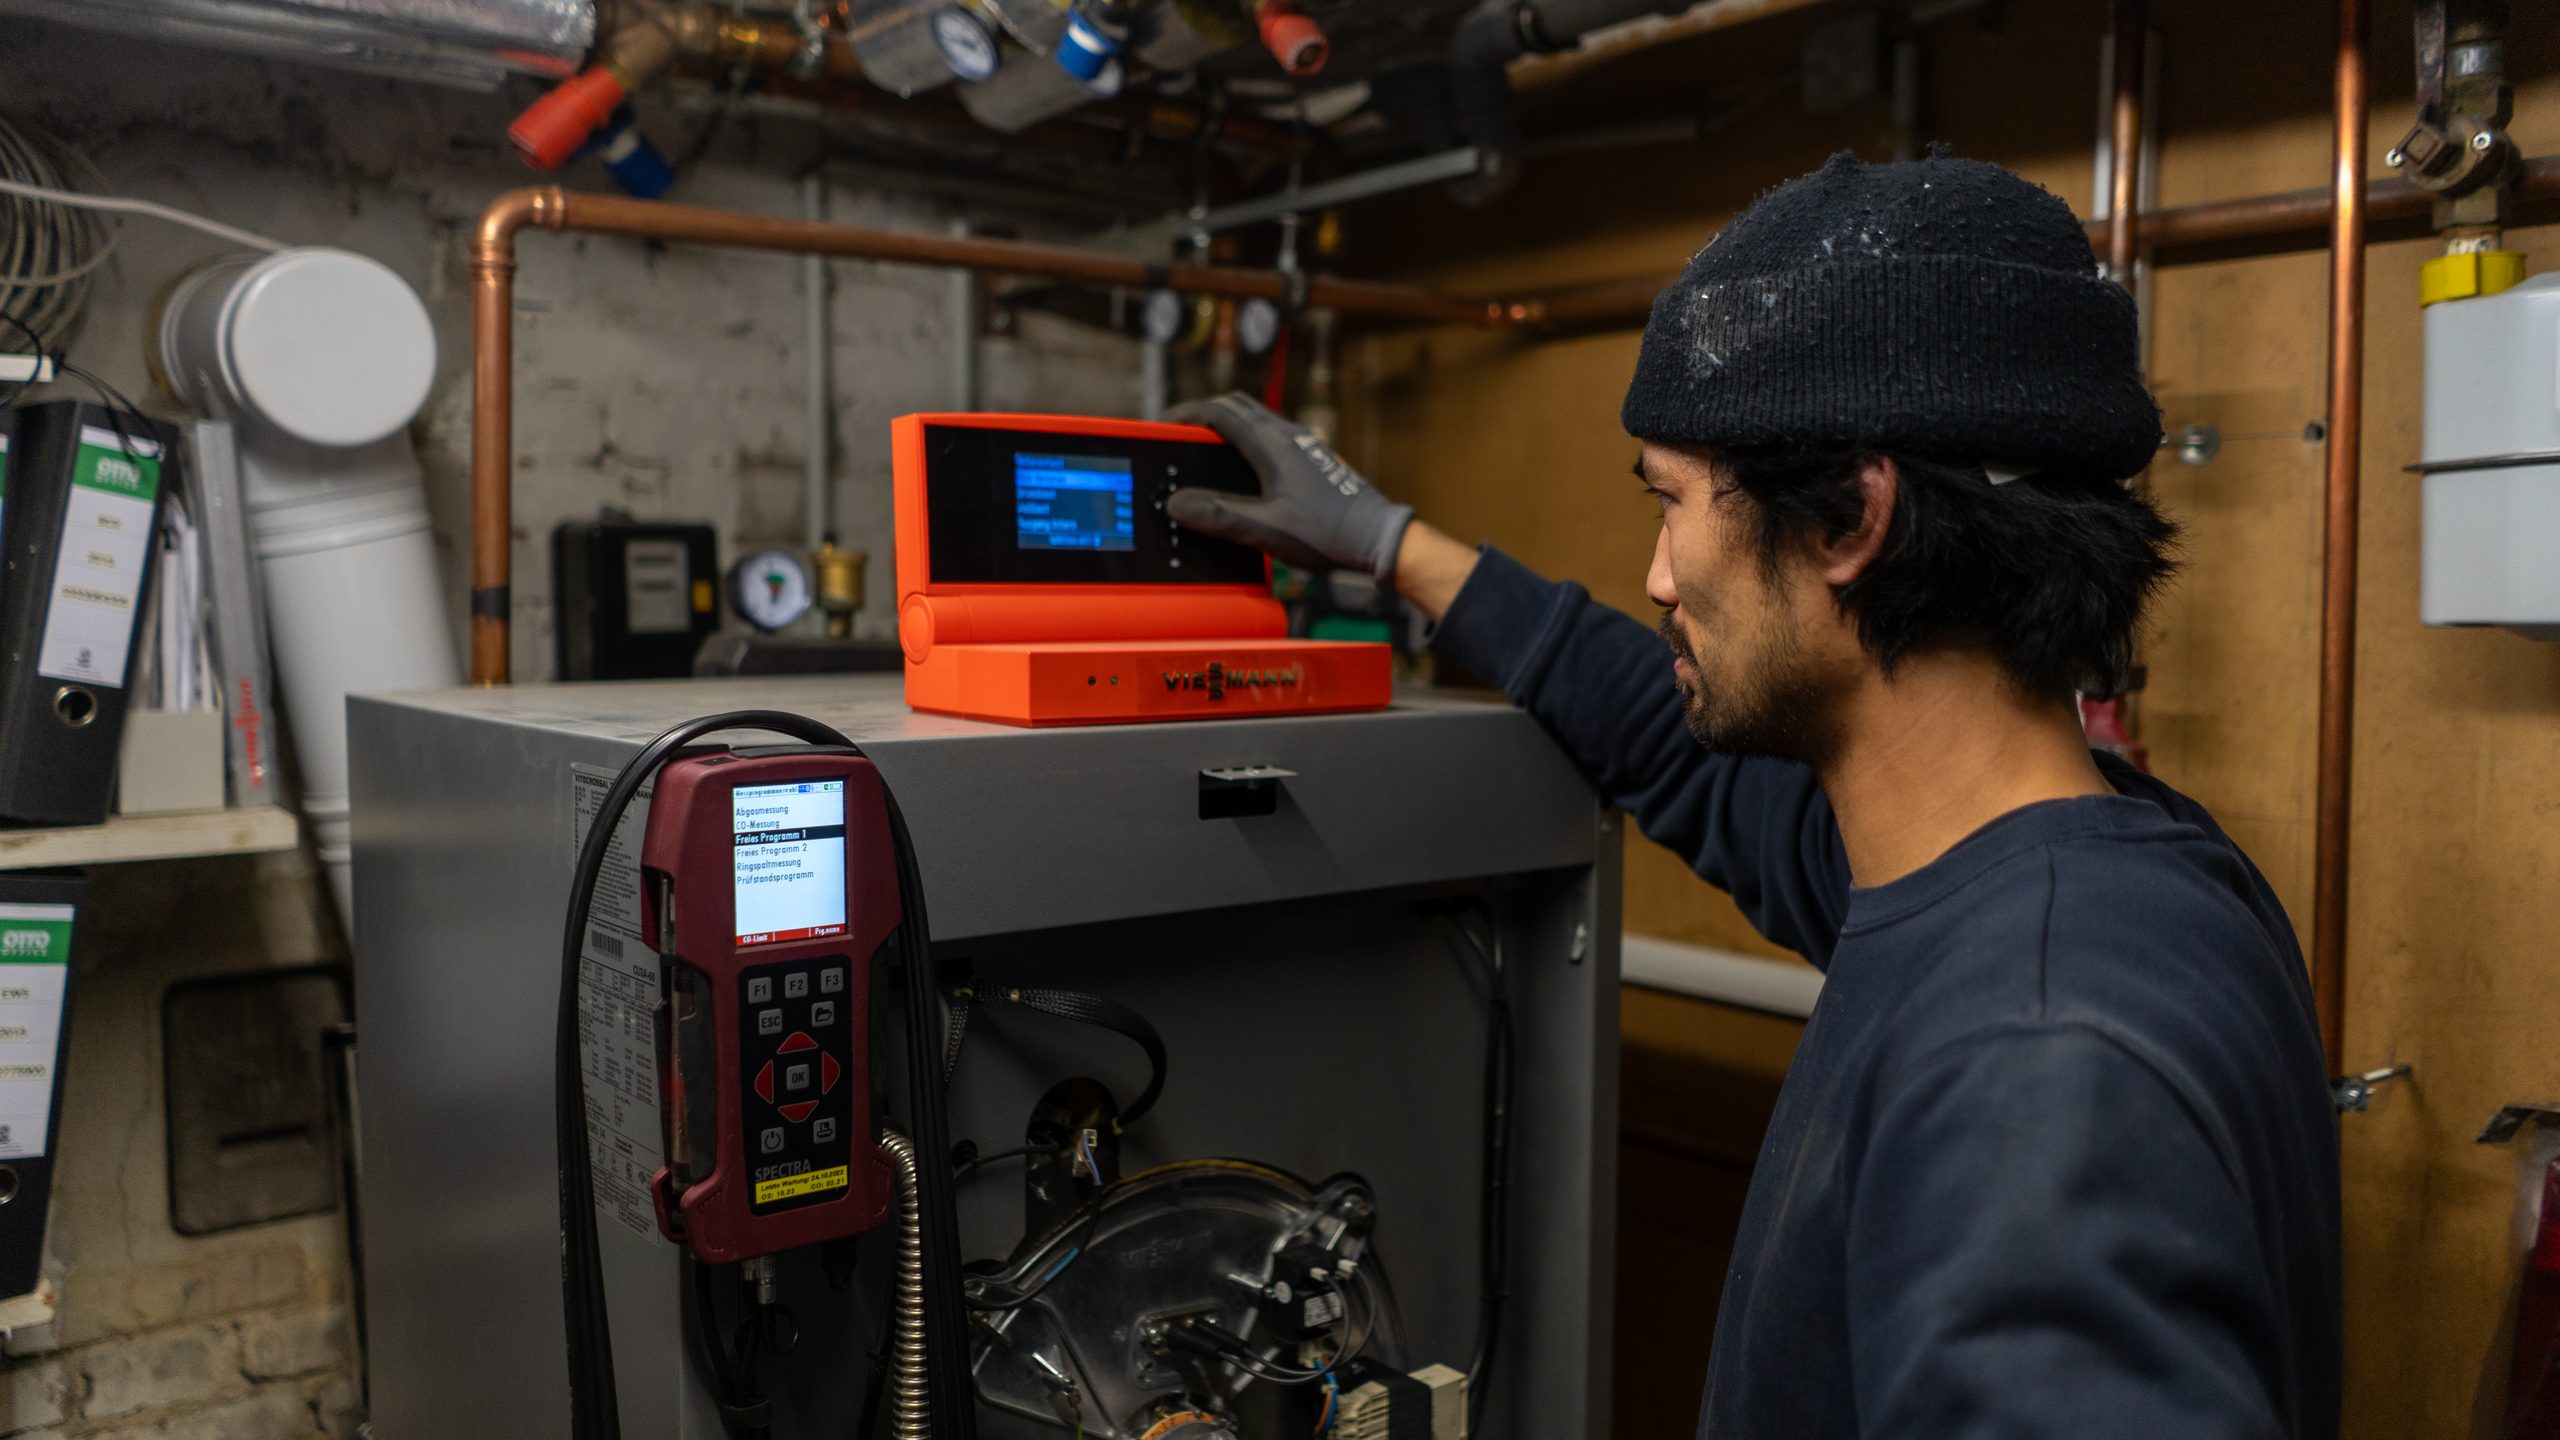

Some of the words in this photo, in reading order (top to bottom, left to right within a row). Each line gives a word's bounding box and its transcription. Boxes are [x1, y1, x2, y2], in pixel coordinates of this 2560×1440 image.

[1161, 662, 1298, 701] VIESSMANN
[736, 807, 788, 817] Abgasmessung
[736, 820, 780, 830] CO-Messung
[736, 834, 759, 844] Freies
[760, 832, 800, 843] Programm
[802, 829, 807, 838] 1
[736, 847, 759, 858] Freies
[761, 845, 800, 856] Programm
[802, 843, 808, 852] 2
[736, 859, 802, 872] Ringspaltmessung
[737, 870, 814, 886] Prüfstandsprogramm
[3, 930, 51, 948] OTTO
[754, 985, 767, 997] F1
[790, 979, 804, 991] F2
[825, 974, 839, 987] F3
[761, 1016, 781, 1029] ESC
[791, 1072, 805, 1084] OK
[755, 1159, 812, 1182] SPECTRA
